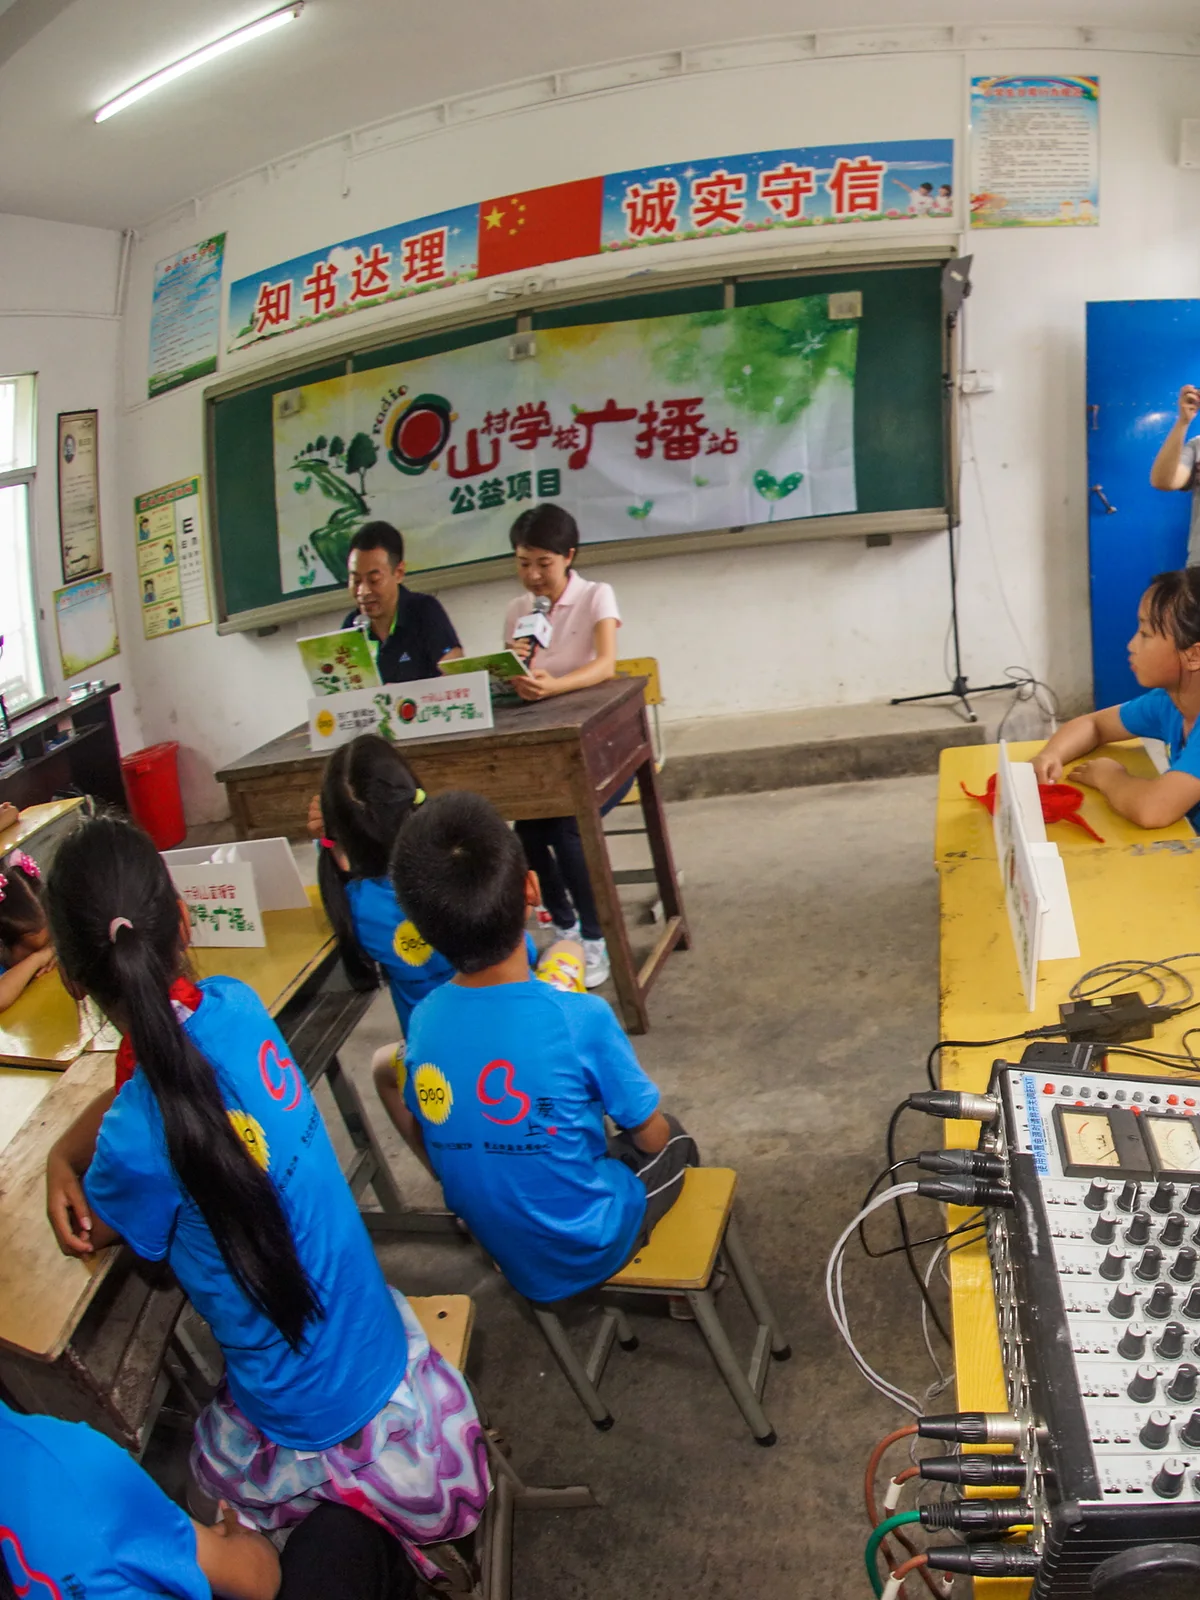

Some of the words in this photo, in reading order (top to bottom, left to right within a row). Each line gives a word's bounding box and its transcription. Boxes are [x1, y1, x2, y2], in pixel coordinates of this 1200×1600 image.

[625, 159, 884, 237] 诚实守信
[256, 229, 446, 334] 知书达理
[372, 384, 409, 435] radio
[447, 397, 739, 479] 山村学校广播站
[449, 468, 561, 515] 公益项目
